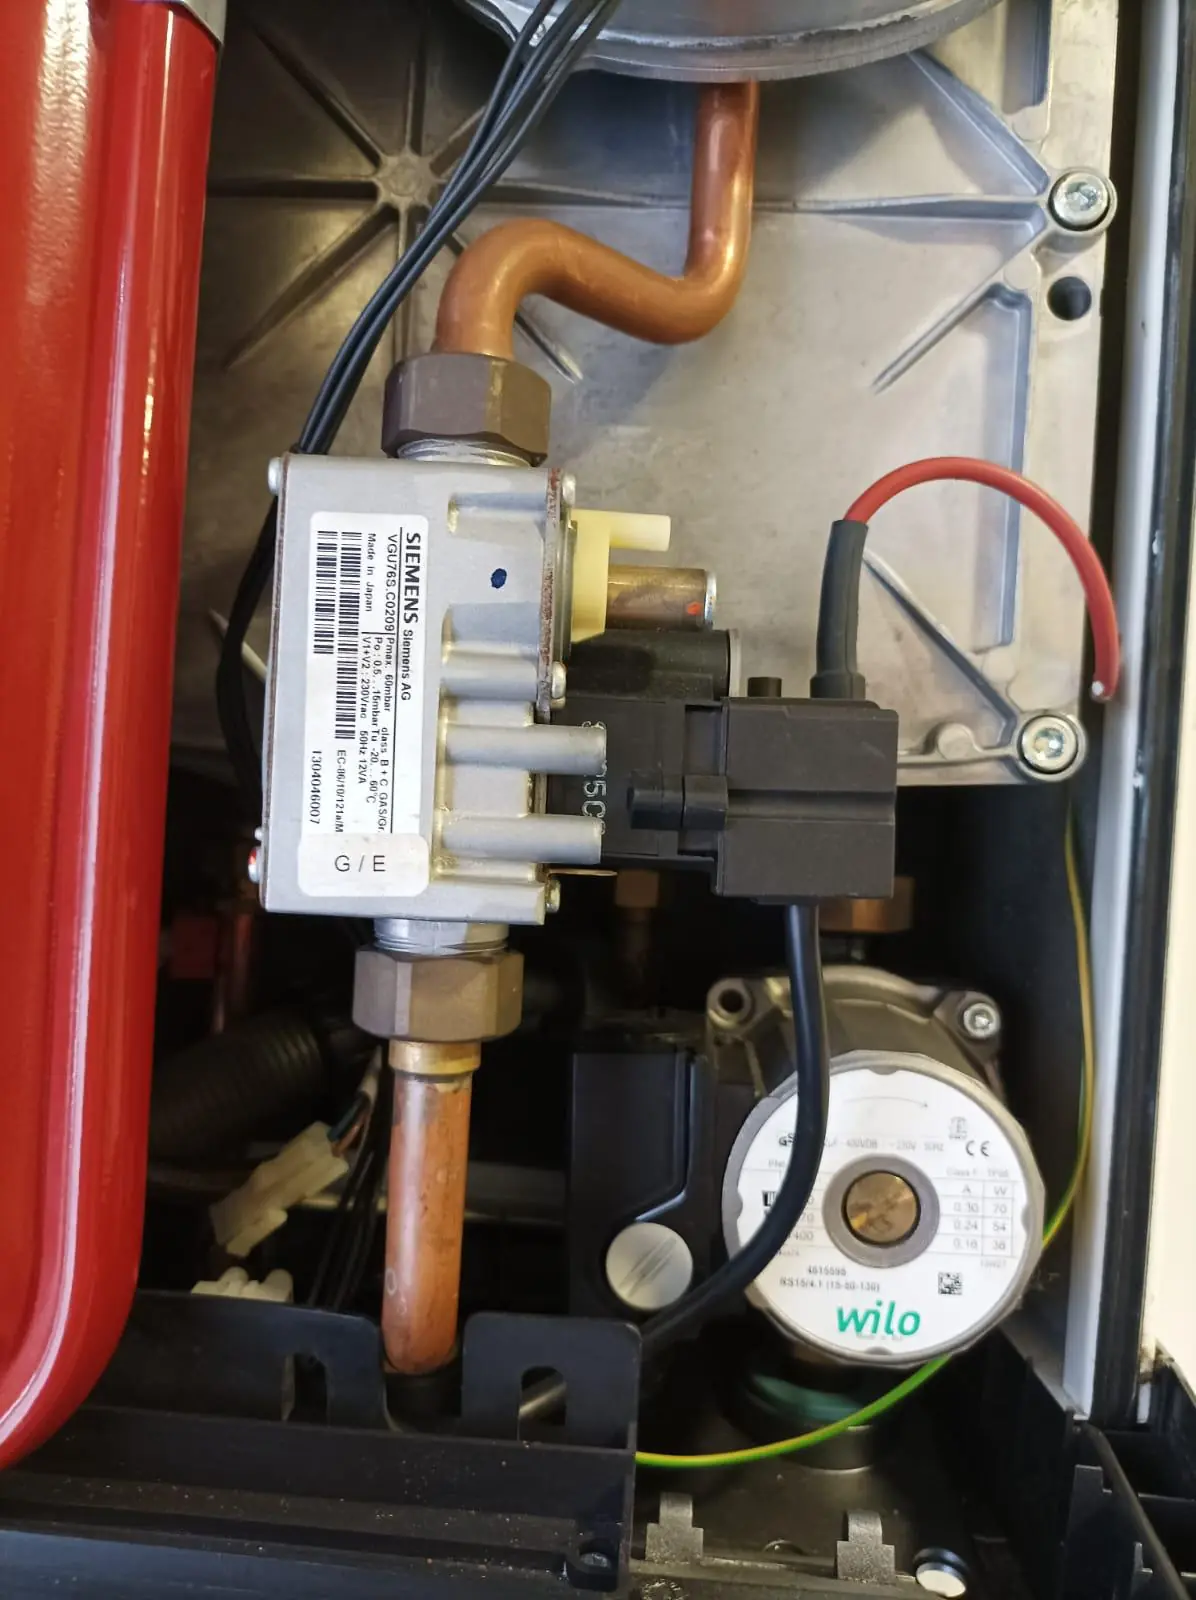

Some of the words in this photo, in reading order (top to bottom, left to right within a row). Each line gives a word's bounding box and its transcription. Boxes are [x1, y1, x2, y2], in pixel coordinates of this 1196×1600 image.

[366, 533, 376, 560] Made
[384, 534, 398, 632] VGU76S.C0209
[403, 532, 421, 624] SIEMENS
[363, 582, 375, 612] Japan
[361, 636, 371, 669] V1+V2
[401, 629, 413, 679] Siemens
[383, 674, 394, 712] 60mbar
[401, 682, 411, 701] AG
[358, 730, 367, 755] 50Hz
[371, 730, 380, 742] Tu
[380, 727, 390, 754] class
[357, 758, 366, 784] 12VA
[381, 759, 389, 767] B
[309, 750, 323, 825] 1304046007
[379, 778, 388, 786] C
[334, 855, 351, 872] G
[358, 855, 365, 872] /
[373, 855, 386, 872] E
[965, 1140, 990, 1157] CE
[962, 1184, 972, 1194] A
[993, 1186, 1008, 1196] W
[993, 1203, 1008, 1214] 70
[836, 1300, 921, 1337] wilo
